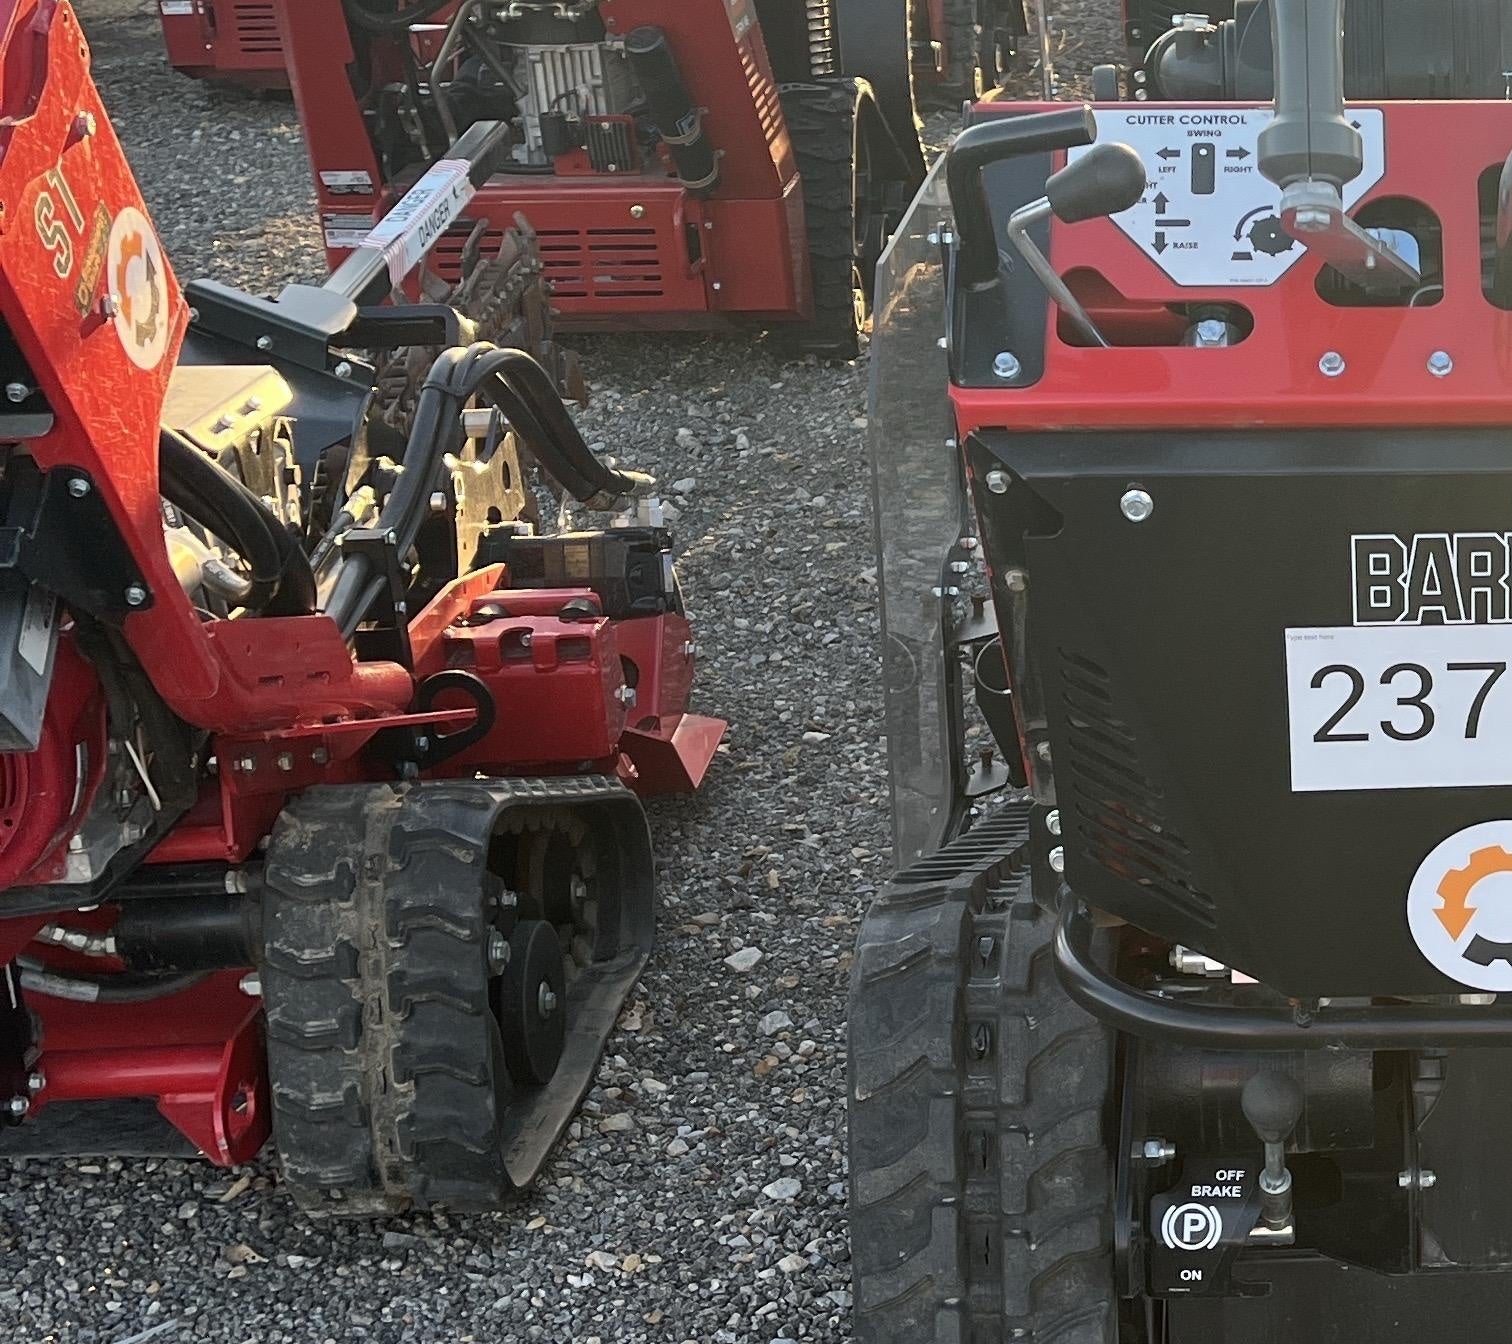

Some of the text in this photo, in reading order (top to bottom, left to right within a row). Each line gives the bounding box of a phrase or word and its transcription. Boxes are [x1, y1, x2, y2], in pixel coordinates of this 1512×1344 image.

[1126, 115, 1248, 125] CUTTER CONTROL
[1187, 129, 1222, 137] SWING
[1158, 166, 1253, 174] LEFT RIGHT
[385, 188, 436, 223] DANGER
[418, 197, 451, 248] DANGER
[1172, 241, 1199, 250] RAISE
[1215, 1169, 1246, 1181] OFF
[1191, 1185, 1242, 1198] BRAKE
[1183, 1212, 1207, 1243] P
[1180, 1269, 1202, 1281] ON
